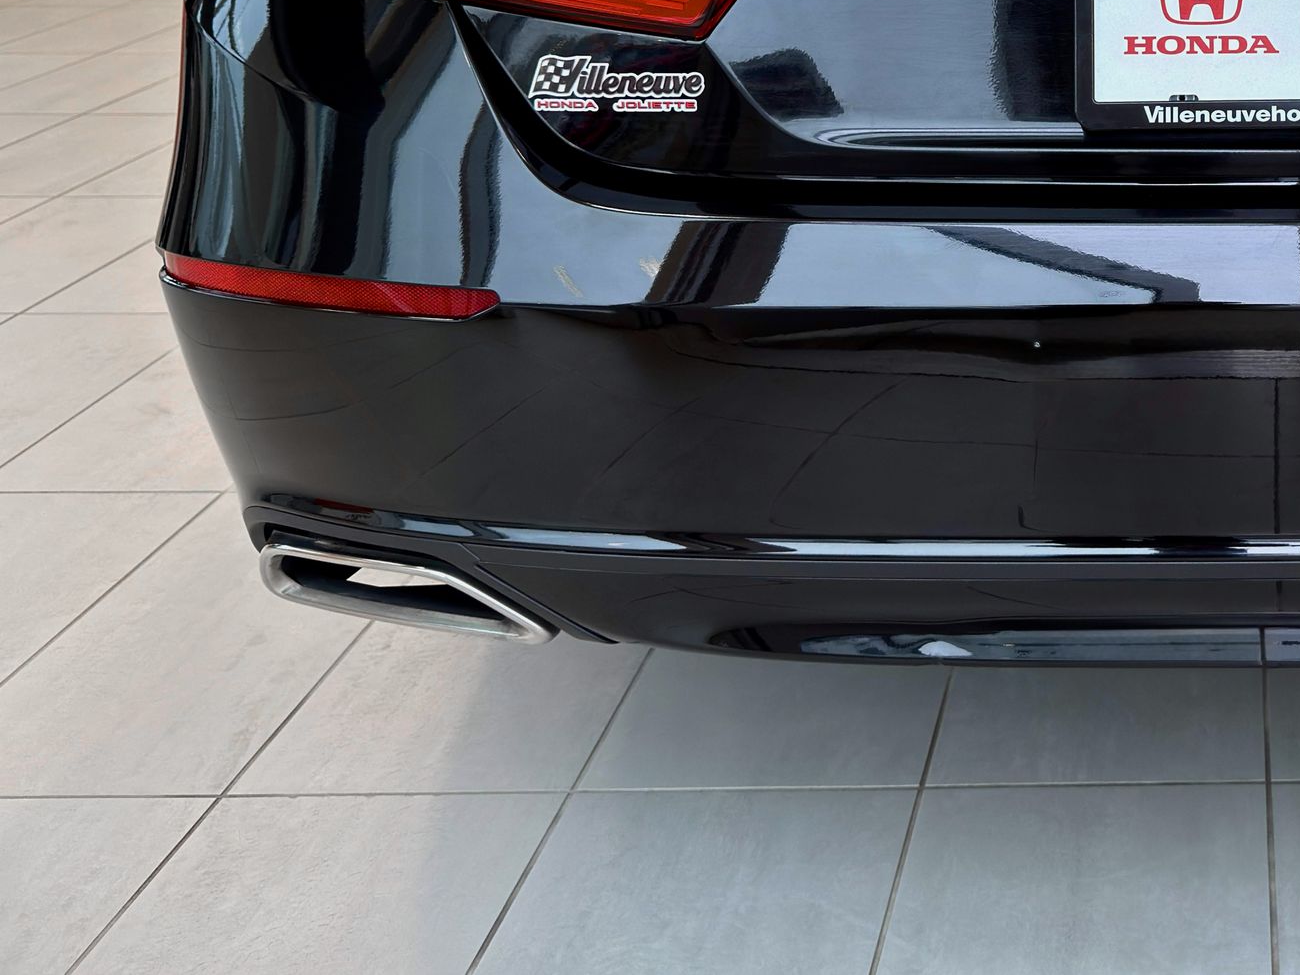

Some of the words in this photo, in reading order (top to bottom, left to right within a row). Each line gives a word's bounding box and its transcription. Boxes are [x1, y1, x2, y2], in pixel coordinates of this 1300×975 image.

[1123, 35, 1280, 55] HONDA
[534, 56, 703, 96] Villeneuve
[536, 101, 598, 110] HONDA
[616, 101, 697, 110] JOLIETTE
